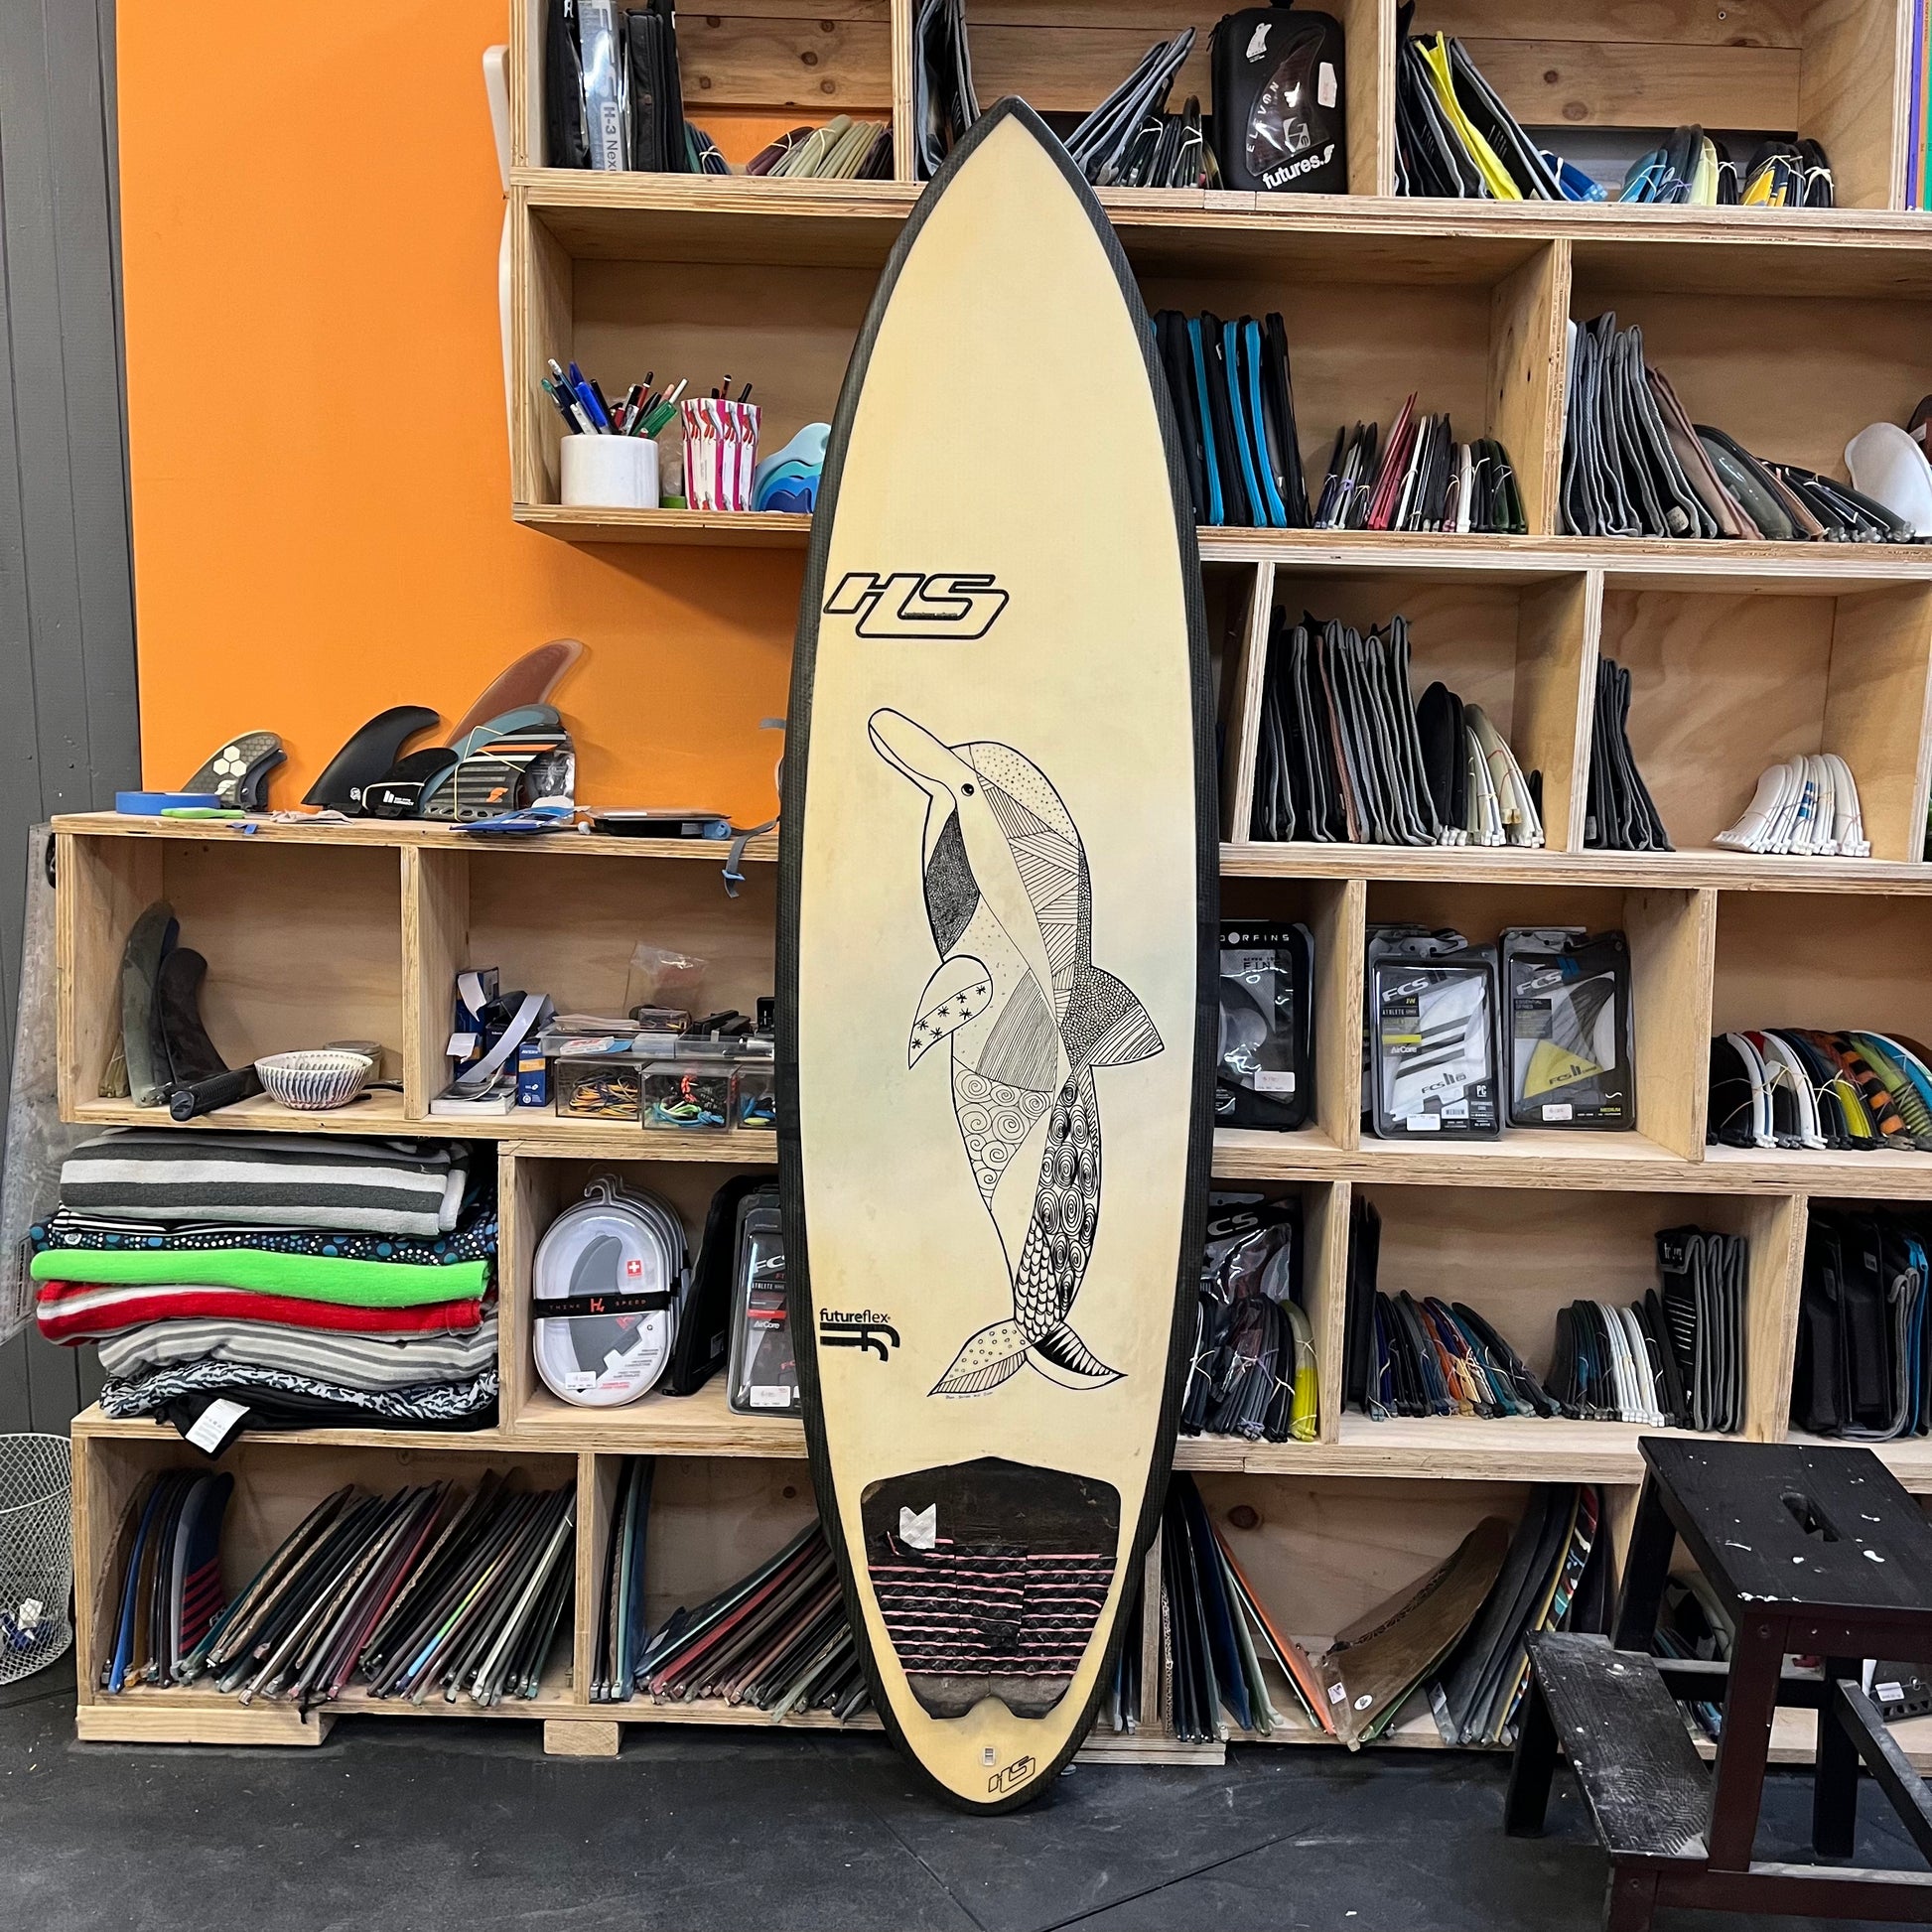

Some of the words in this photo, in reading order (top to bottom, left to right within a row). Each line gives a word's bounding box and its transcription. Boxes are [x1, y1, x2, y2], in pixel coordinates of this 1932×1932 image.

[603, 106, 617, 136] H-3
[1382, 977, 1430, 1003] FCS
[1516, 971, 1563, 996] FCS
[1390, 1045, 1418, 1054] AirCore
[1549, 1075, 1574, 1085] FCS
[1421, 1082, 1446, 1094] FCS
[1476, 1085, 1487, 1095] PC
[754, 1255, 785, 1275] FC
[819, 1308, 889, 1323] futureflex
